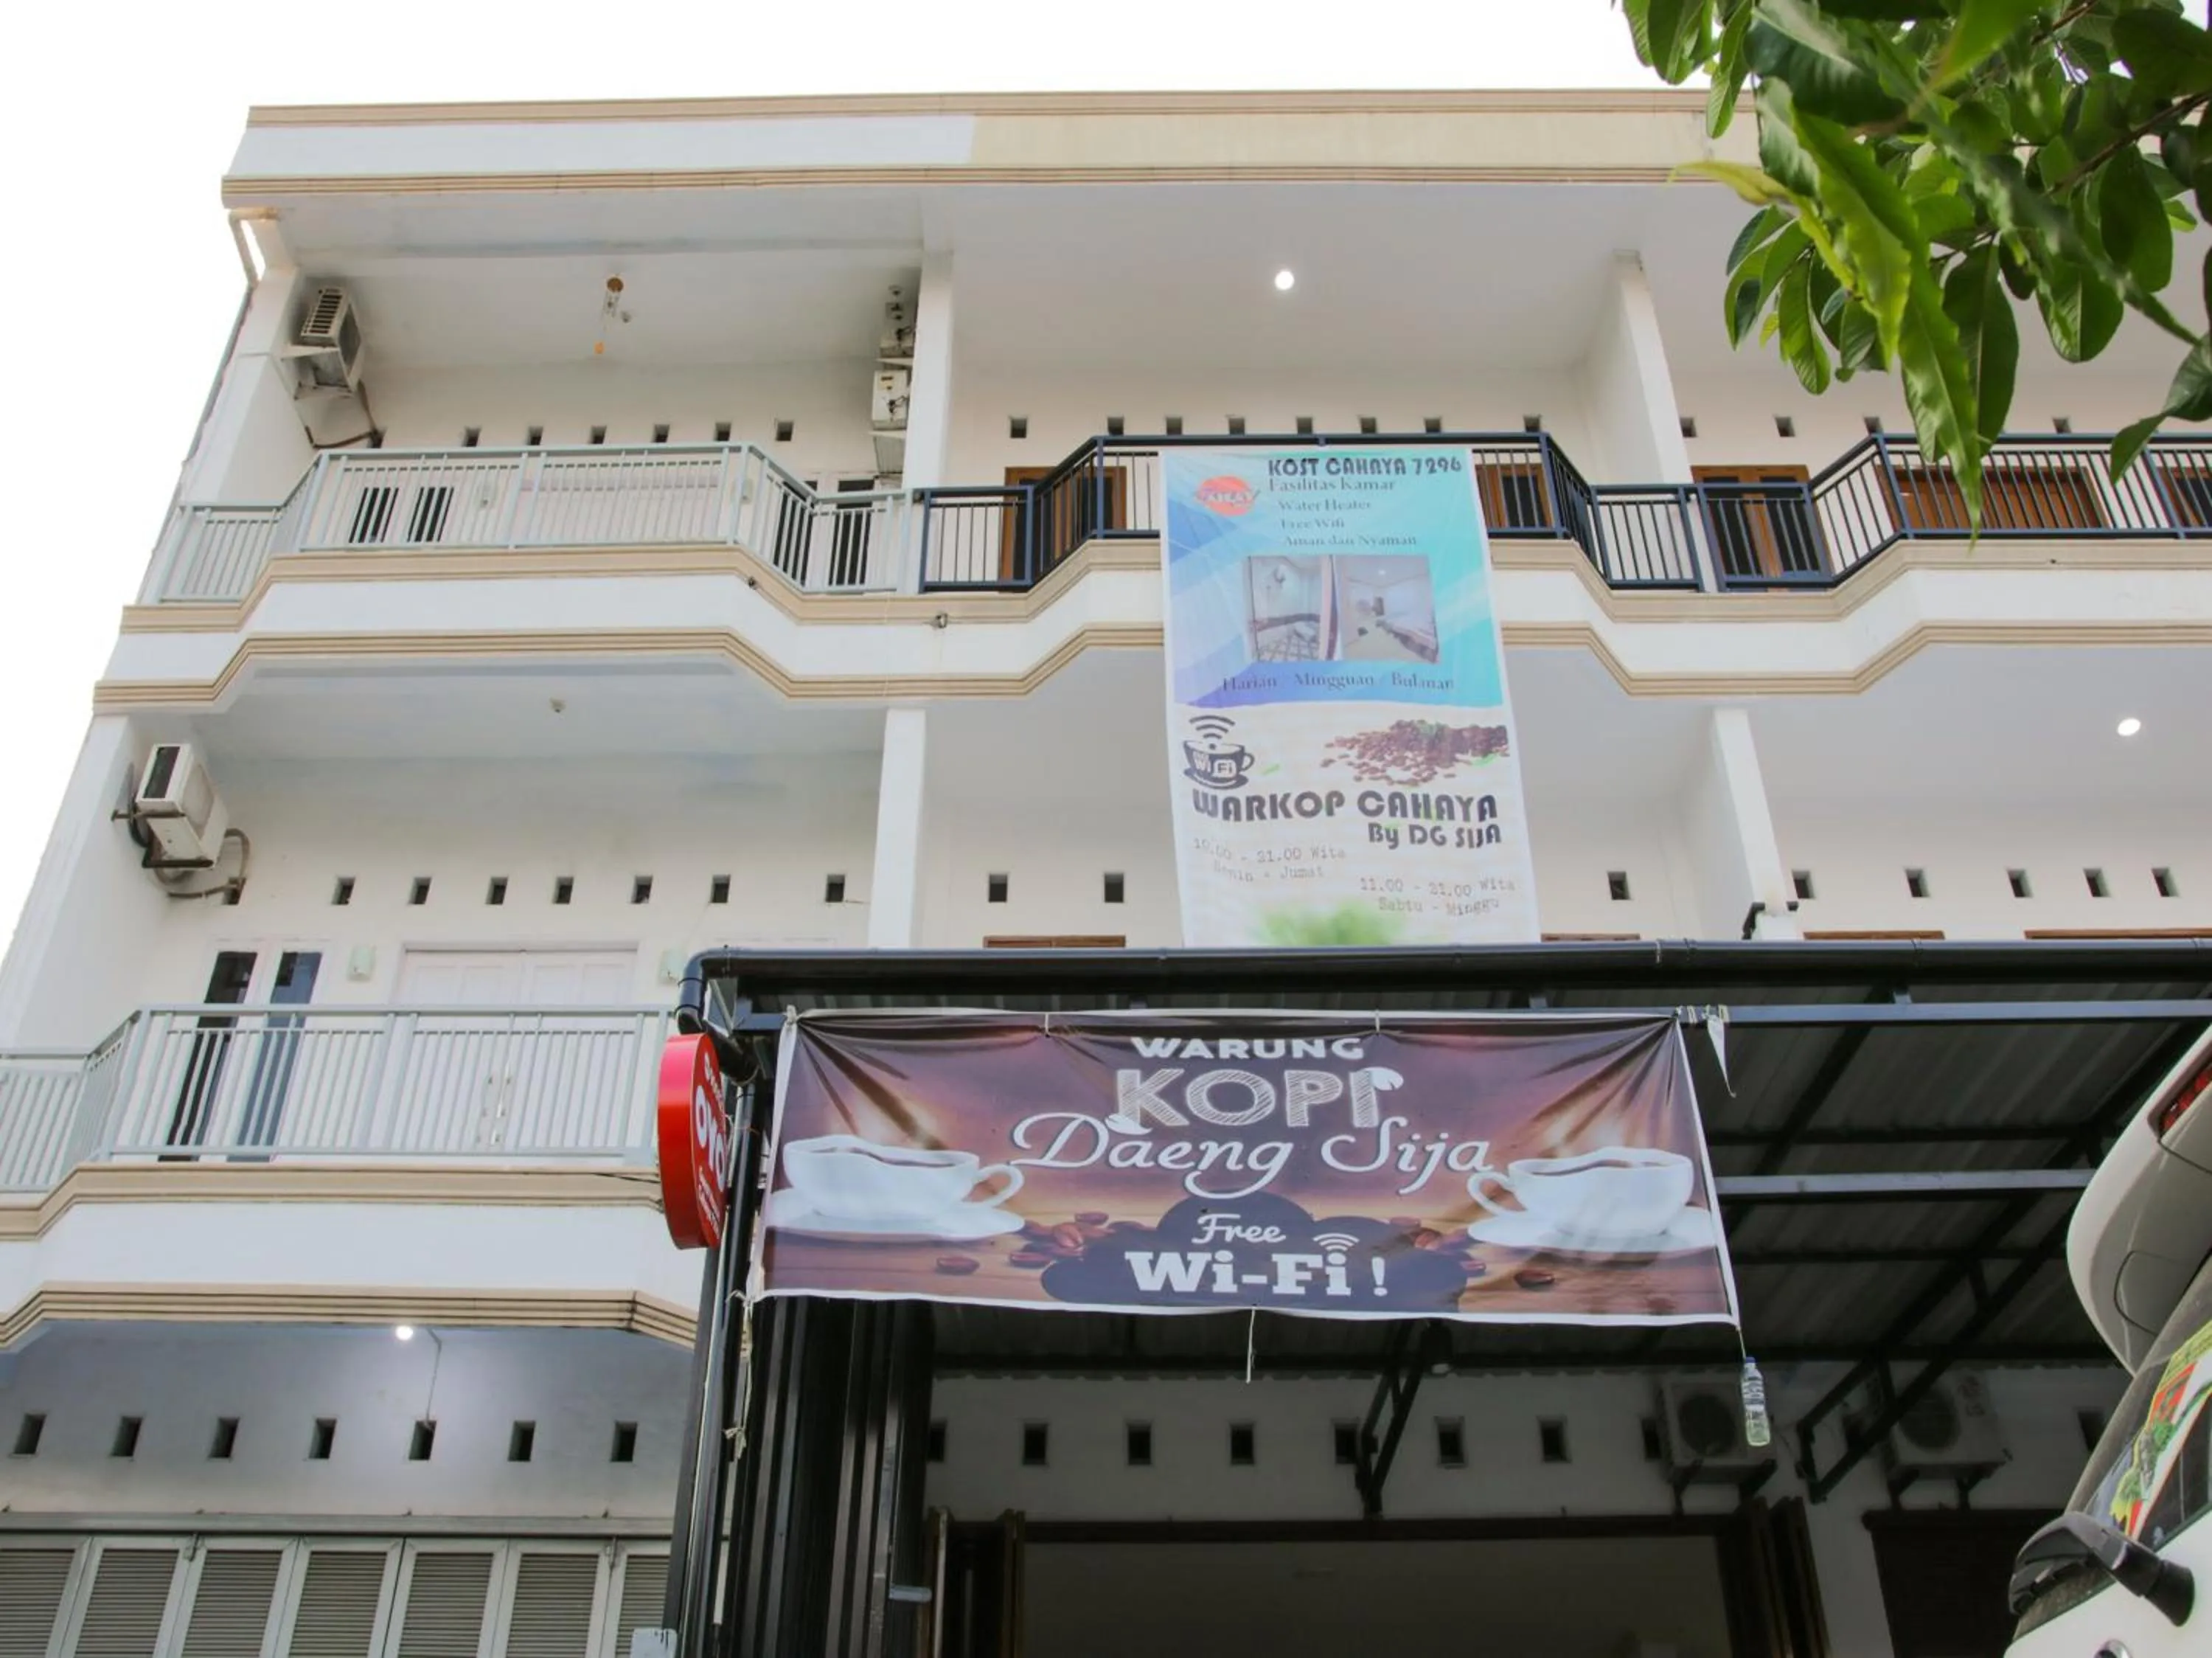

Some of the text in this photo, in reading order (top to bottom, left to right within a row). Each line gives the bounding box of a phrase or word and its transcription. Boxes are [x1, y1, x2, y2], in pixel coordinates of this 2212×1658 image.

[1268, 456, 1462, 476] KOST CAHAYA 7296
[1269, 476, 1396, 493] Fasilitas Kamar
[1192, 788, 1498, 822] WARKOP CAHAYA
[1368, 822, 1502, 850] By DG SIJA
[1129, 1036, 1365, 1061] WARUNG
[1116, 1068, 1385, 1129] KOPI
[1008, 1111, 1495, 1200] Daeng Sija
[1191, 1213, 1287, 1245] Free
